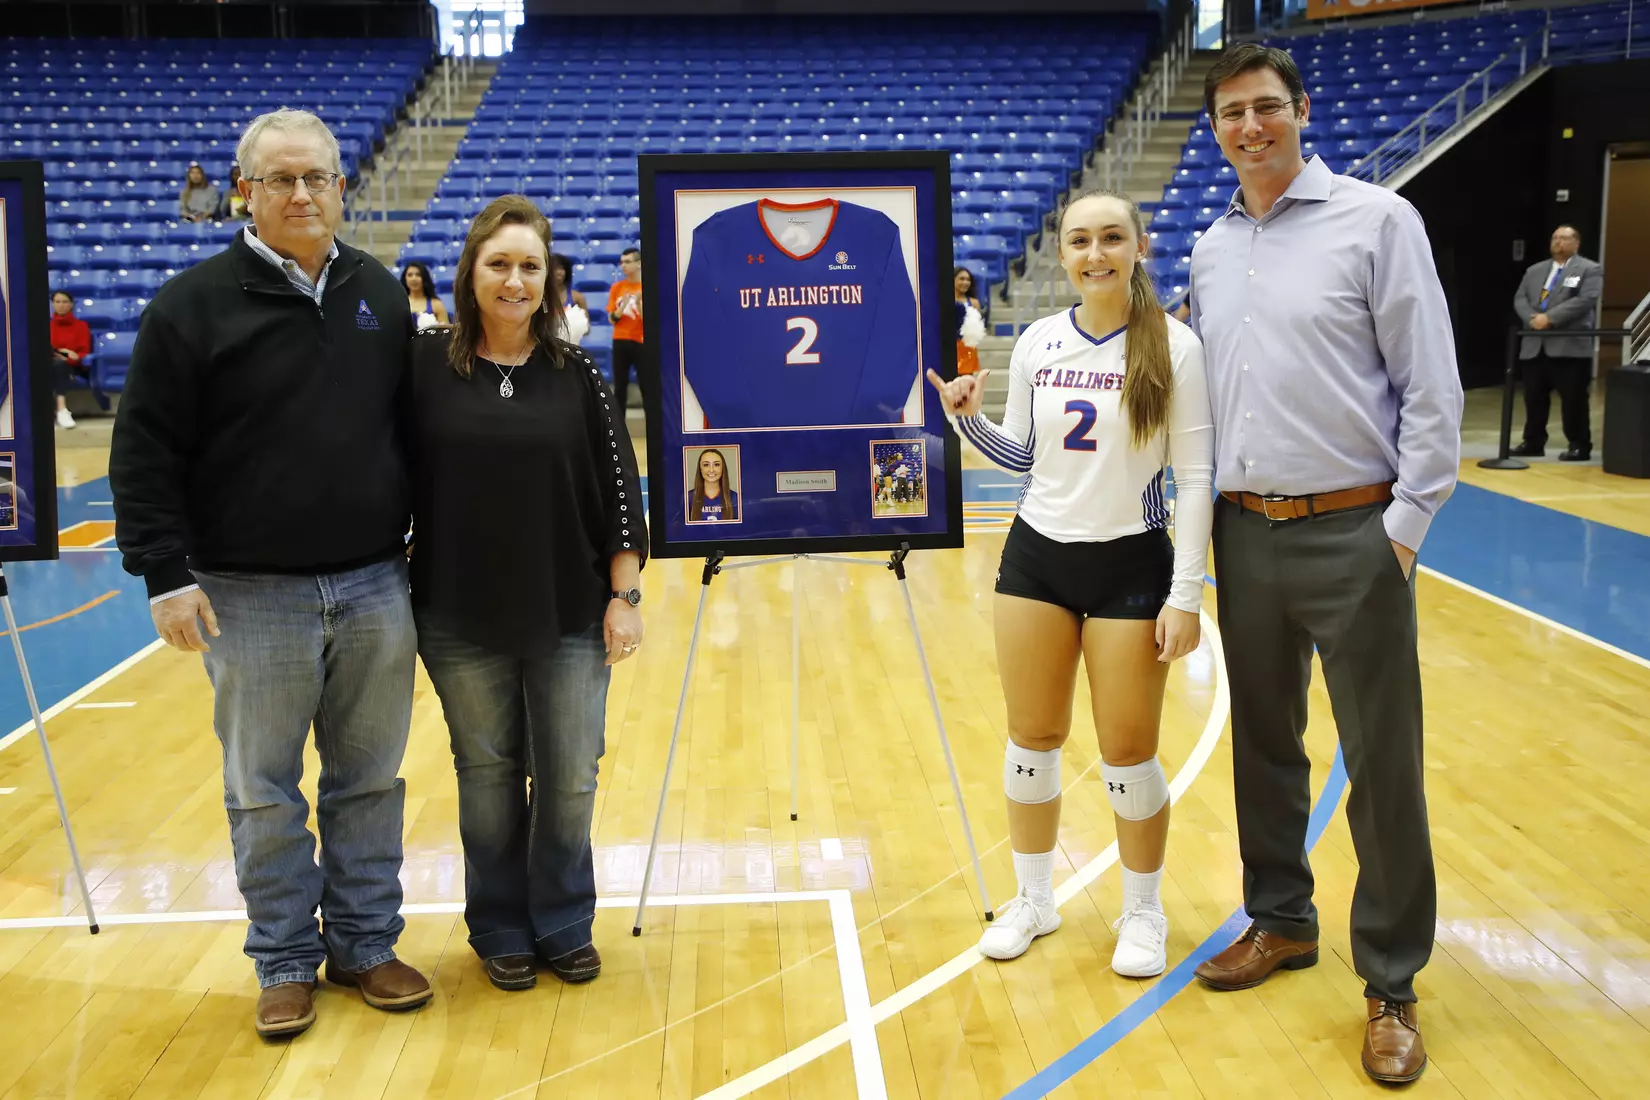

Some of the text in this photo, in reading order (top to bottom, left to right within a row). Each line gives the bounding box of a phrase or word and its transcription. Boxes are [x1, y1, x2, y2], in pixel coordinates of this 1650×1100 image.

[739, 284, 862, 308] UT ARLINGTON
[356, 318, 379, 326] TEXAS
[785, 316, 821, 365] 2
[1063, 399, 1098, 452] 2
